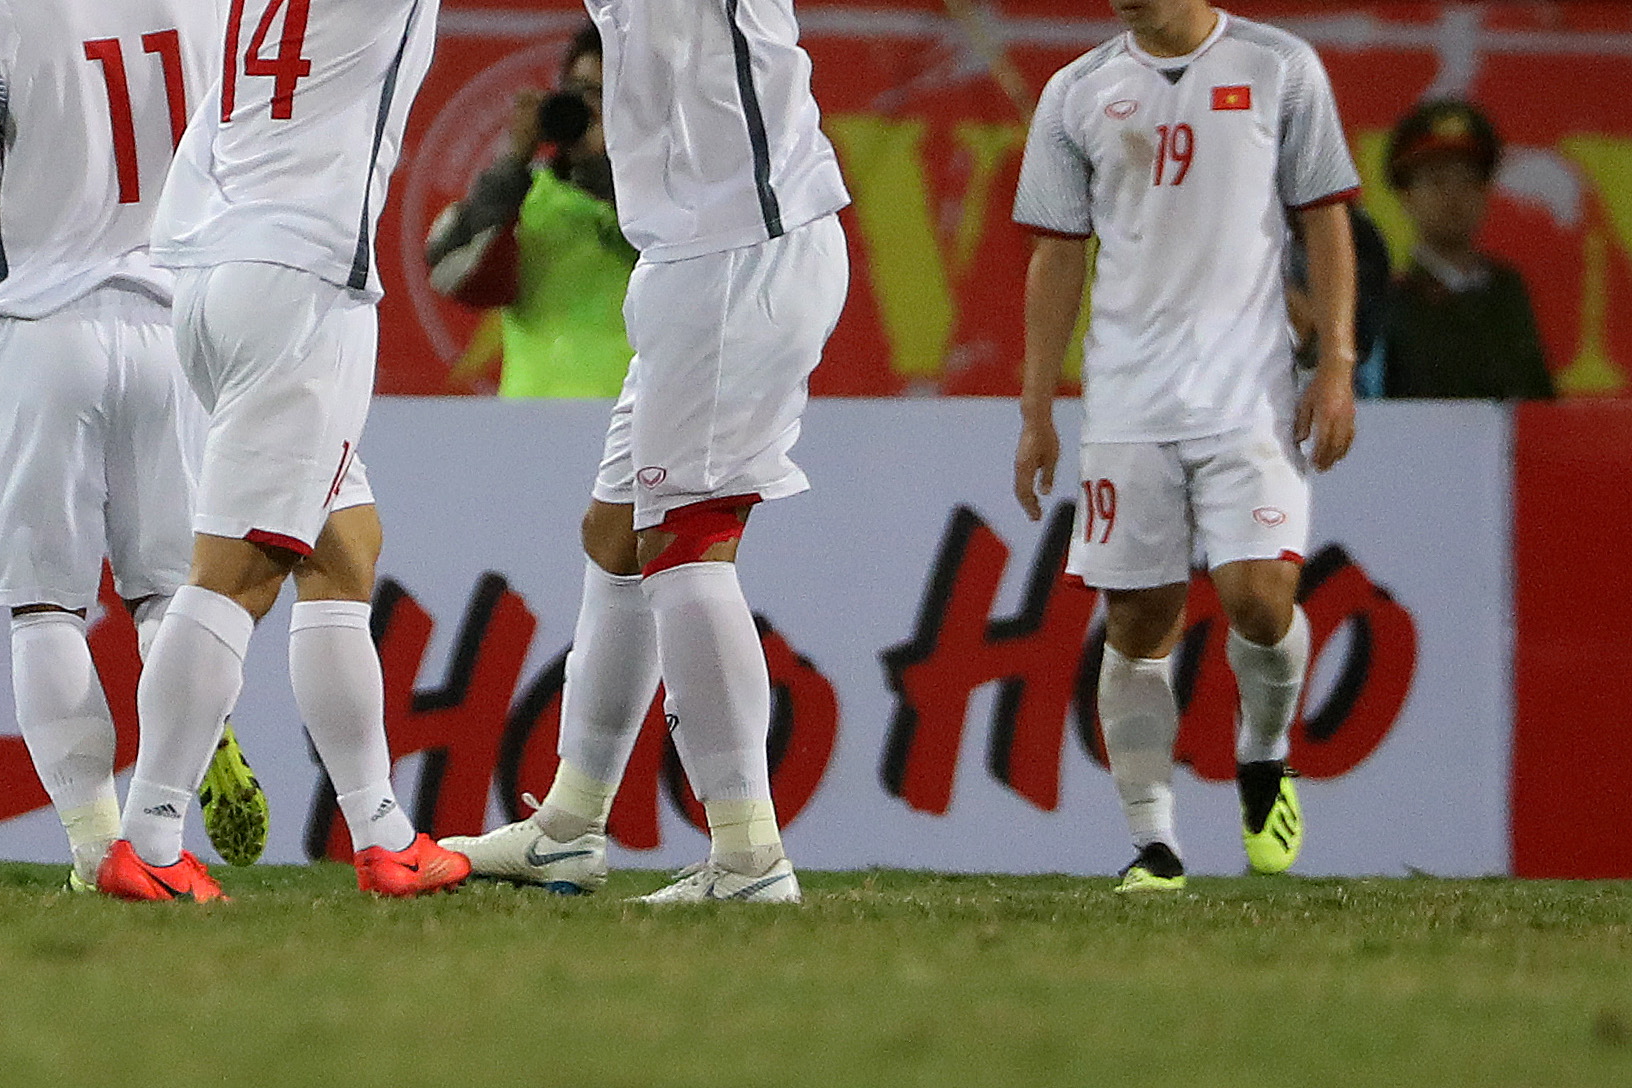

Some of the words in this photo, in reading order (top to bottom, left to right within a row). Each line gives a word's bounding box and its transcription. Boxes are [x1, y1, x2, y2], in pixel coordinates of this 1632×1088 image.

[83, 29, 188, 204] 11
[1154, 122, 1194, 187] 19
[1081, 478, 1116, 544] 19
